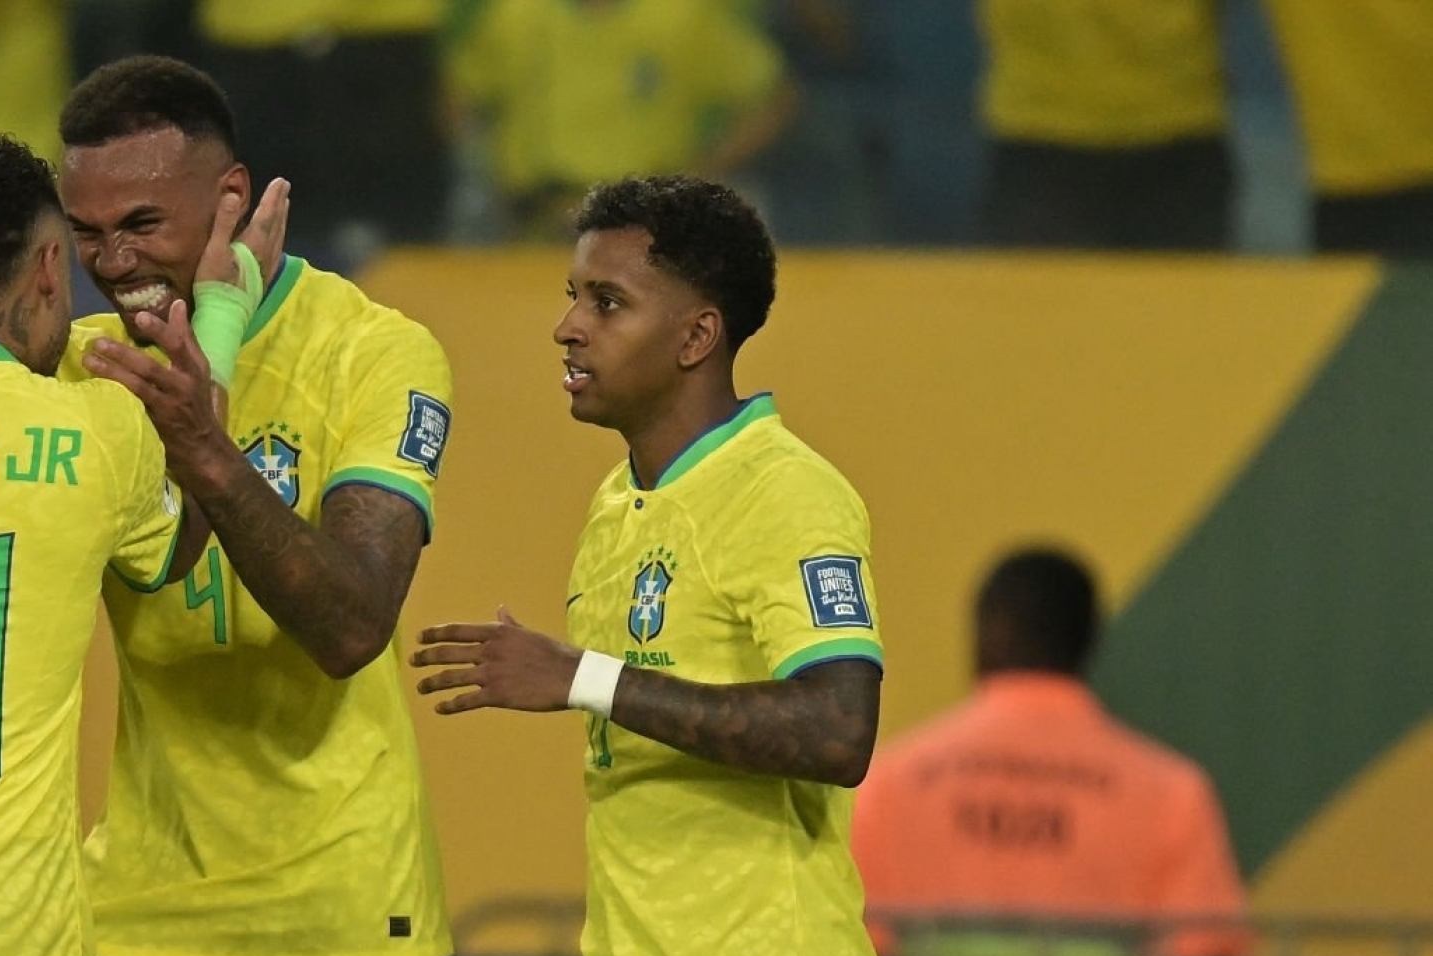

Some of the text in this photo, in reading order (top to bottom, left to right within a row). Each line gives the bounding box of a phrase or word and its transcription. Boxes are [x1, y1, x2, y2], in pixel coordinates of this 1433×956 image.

[6, 427, 83, 486] JR
[184, 546, 227, 644] 4
[820, 577, 854, 593] UNITES
[624, 650, 676, 667] BRASIL
